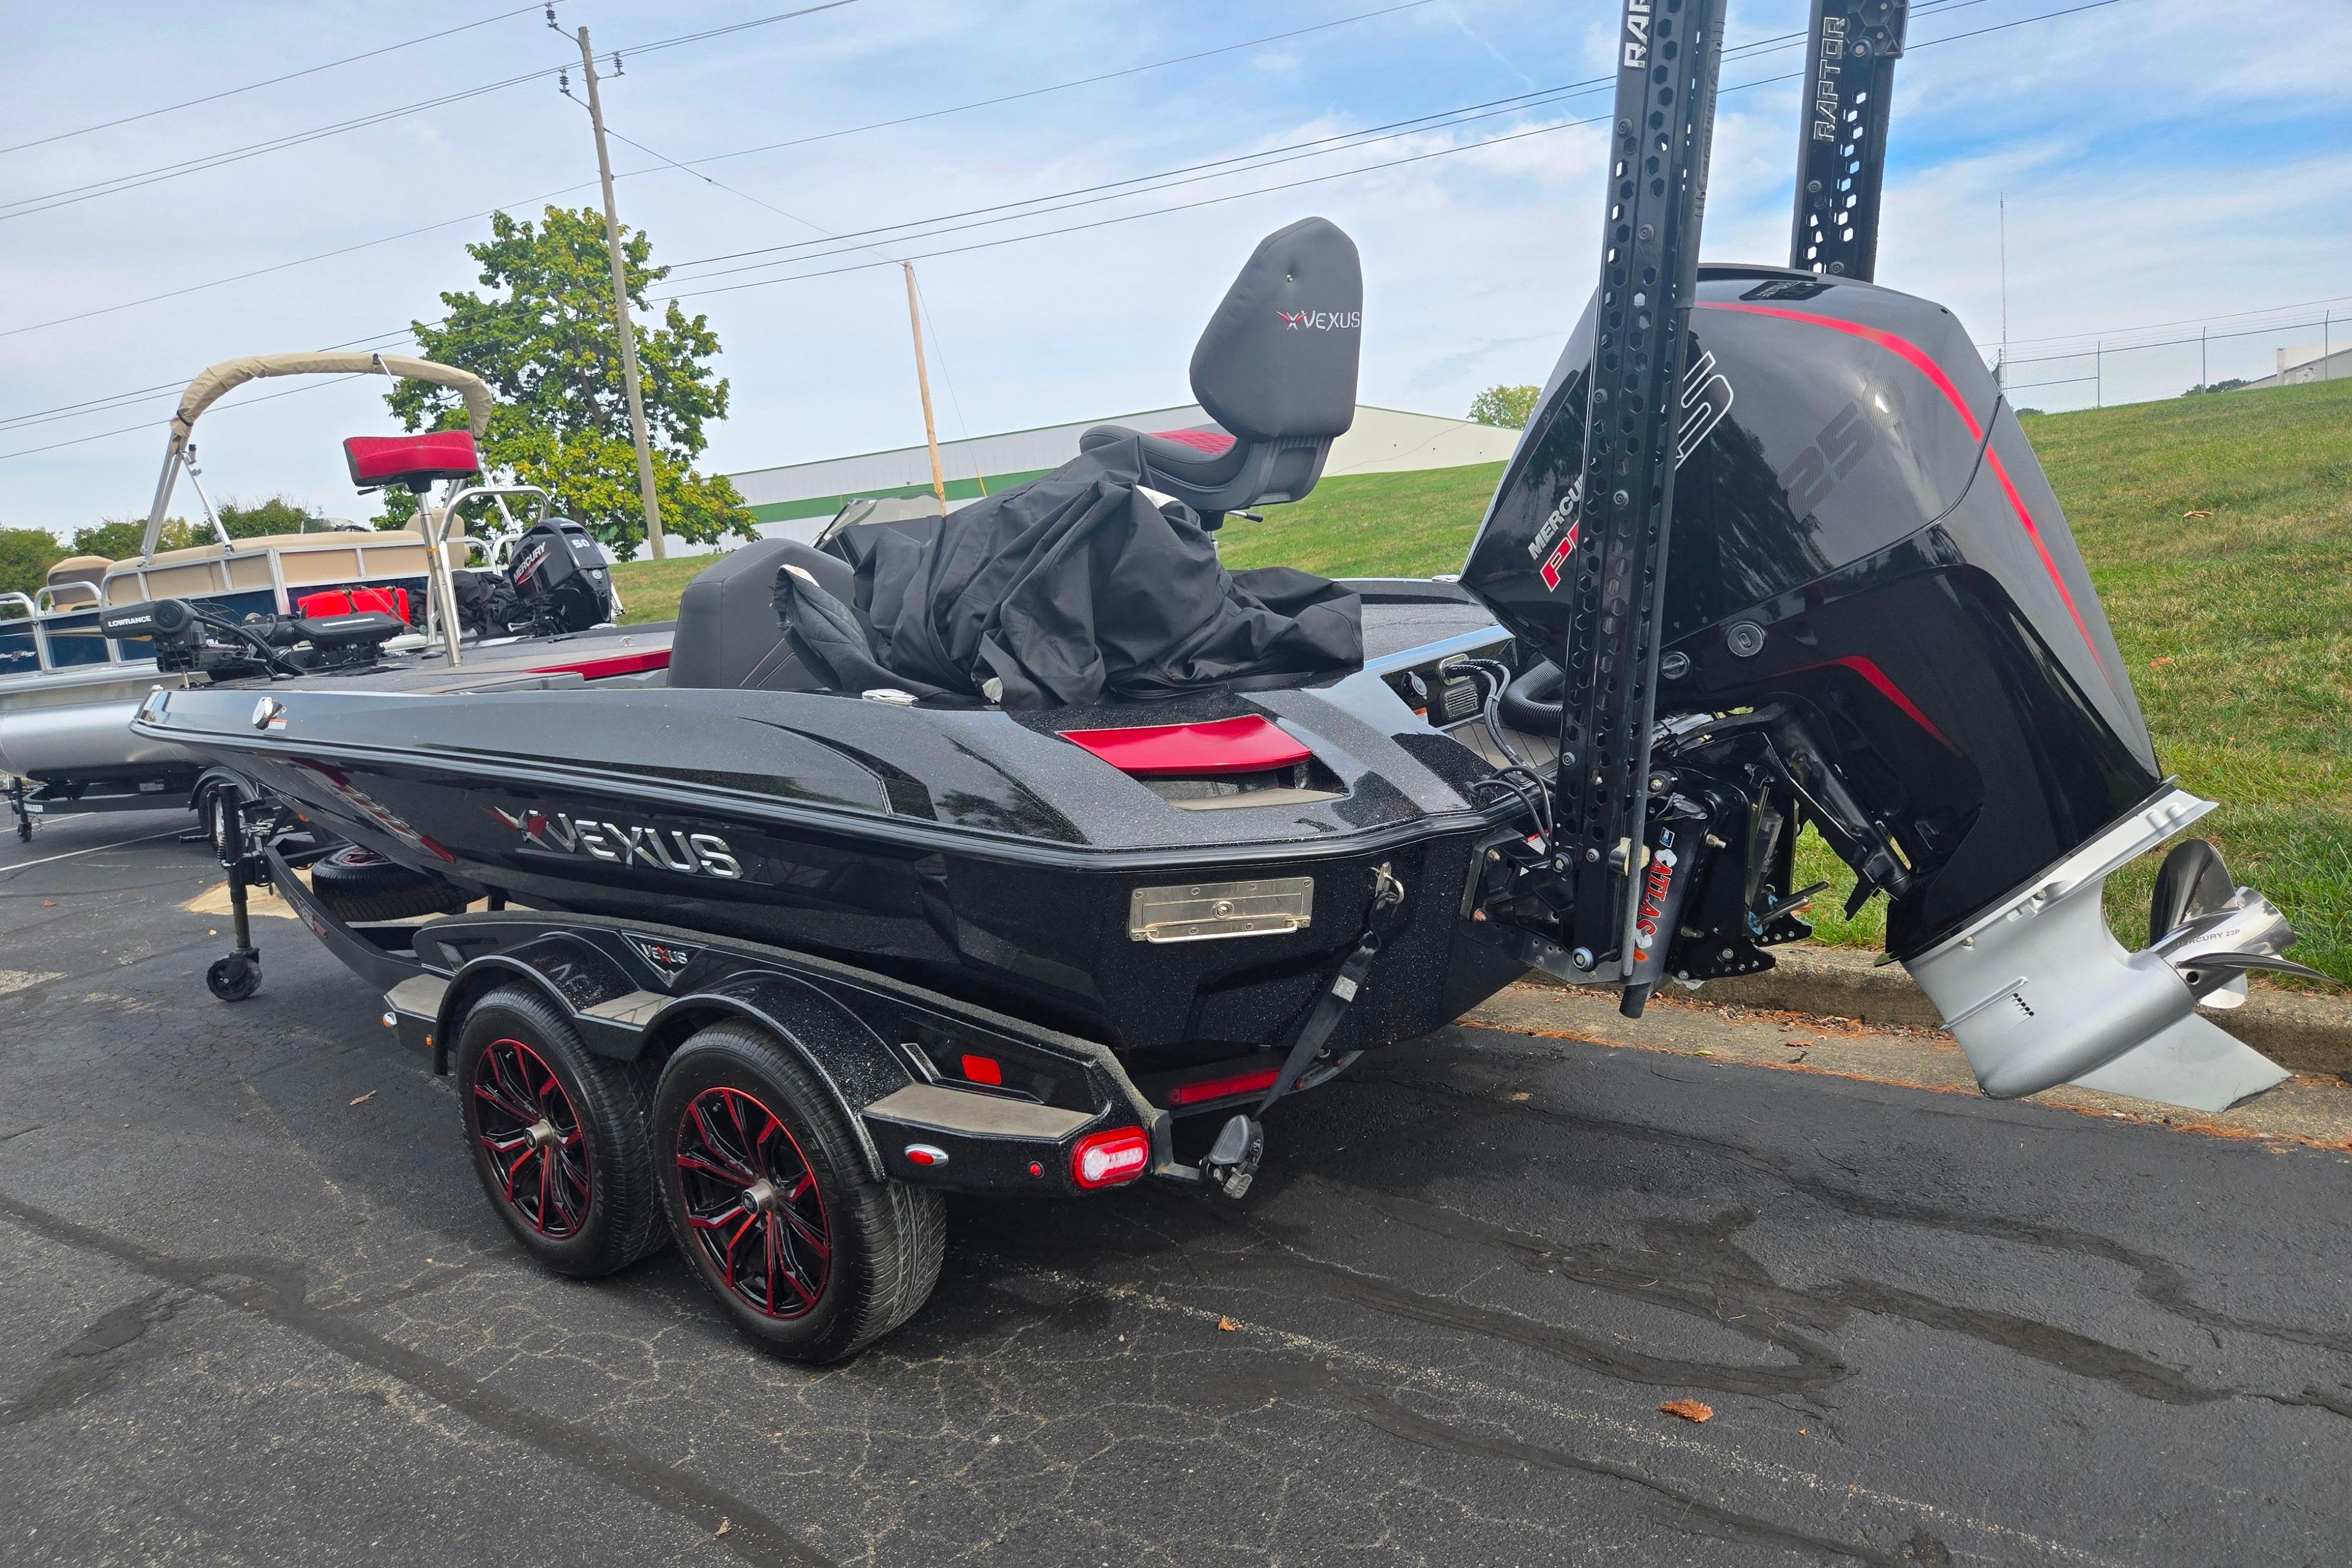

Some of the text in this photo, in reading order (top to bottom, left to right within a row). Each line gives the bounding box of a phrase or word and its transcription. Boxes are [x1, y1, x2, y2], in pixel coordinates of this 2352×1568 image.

[1813, 16, 1846, 143] RAPTOR
[1301, 310, 1361, 332] VEXUS
[1776, 372, 1906, 524] 250
[571, 539, 590, 549] 50
[513, 541, 546, 583] MERCURY
[108, 615, 152, 628] LOWRANCE
[528, 809, 744, 880] VEXUS
[1636, 855, 1673, 937] ATLAS
[2226, 929, 2240, 937] 23P
[640, 943, 689, 965] VEXUS
